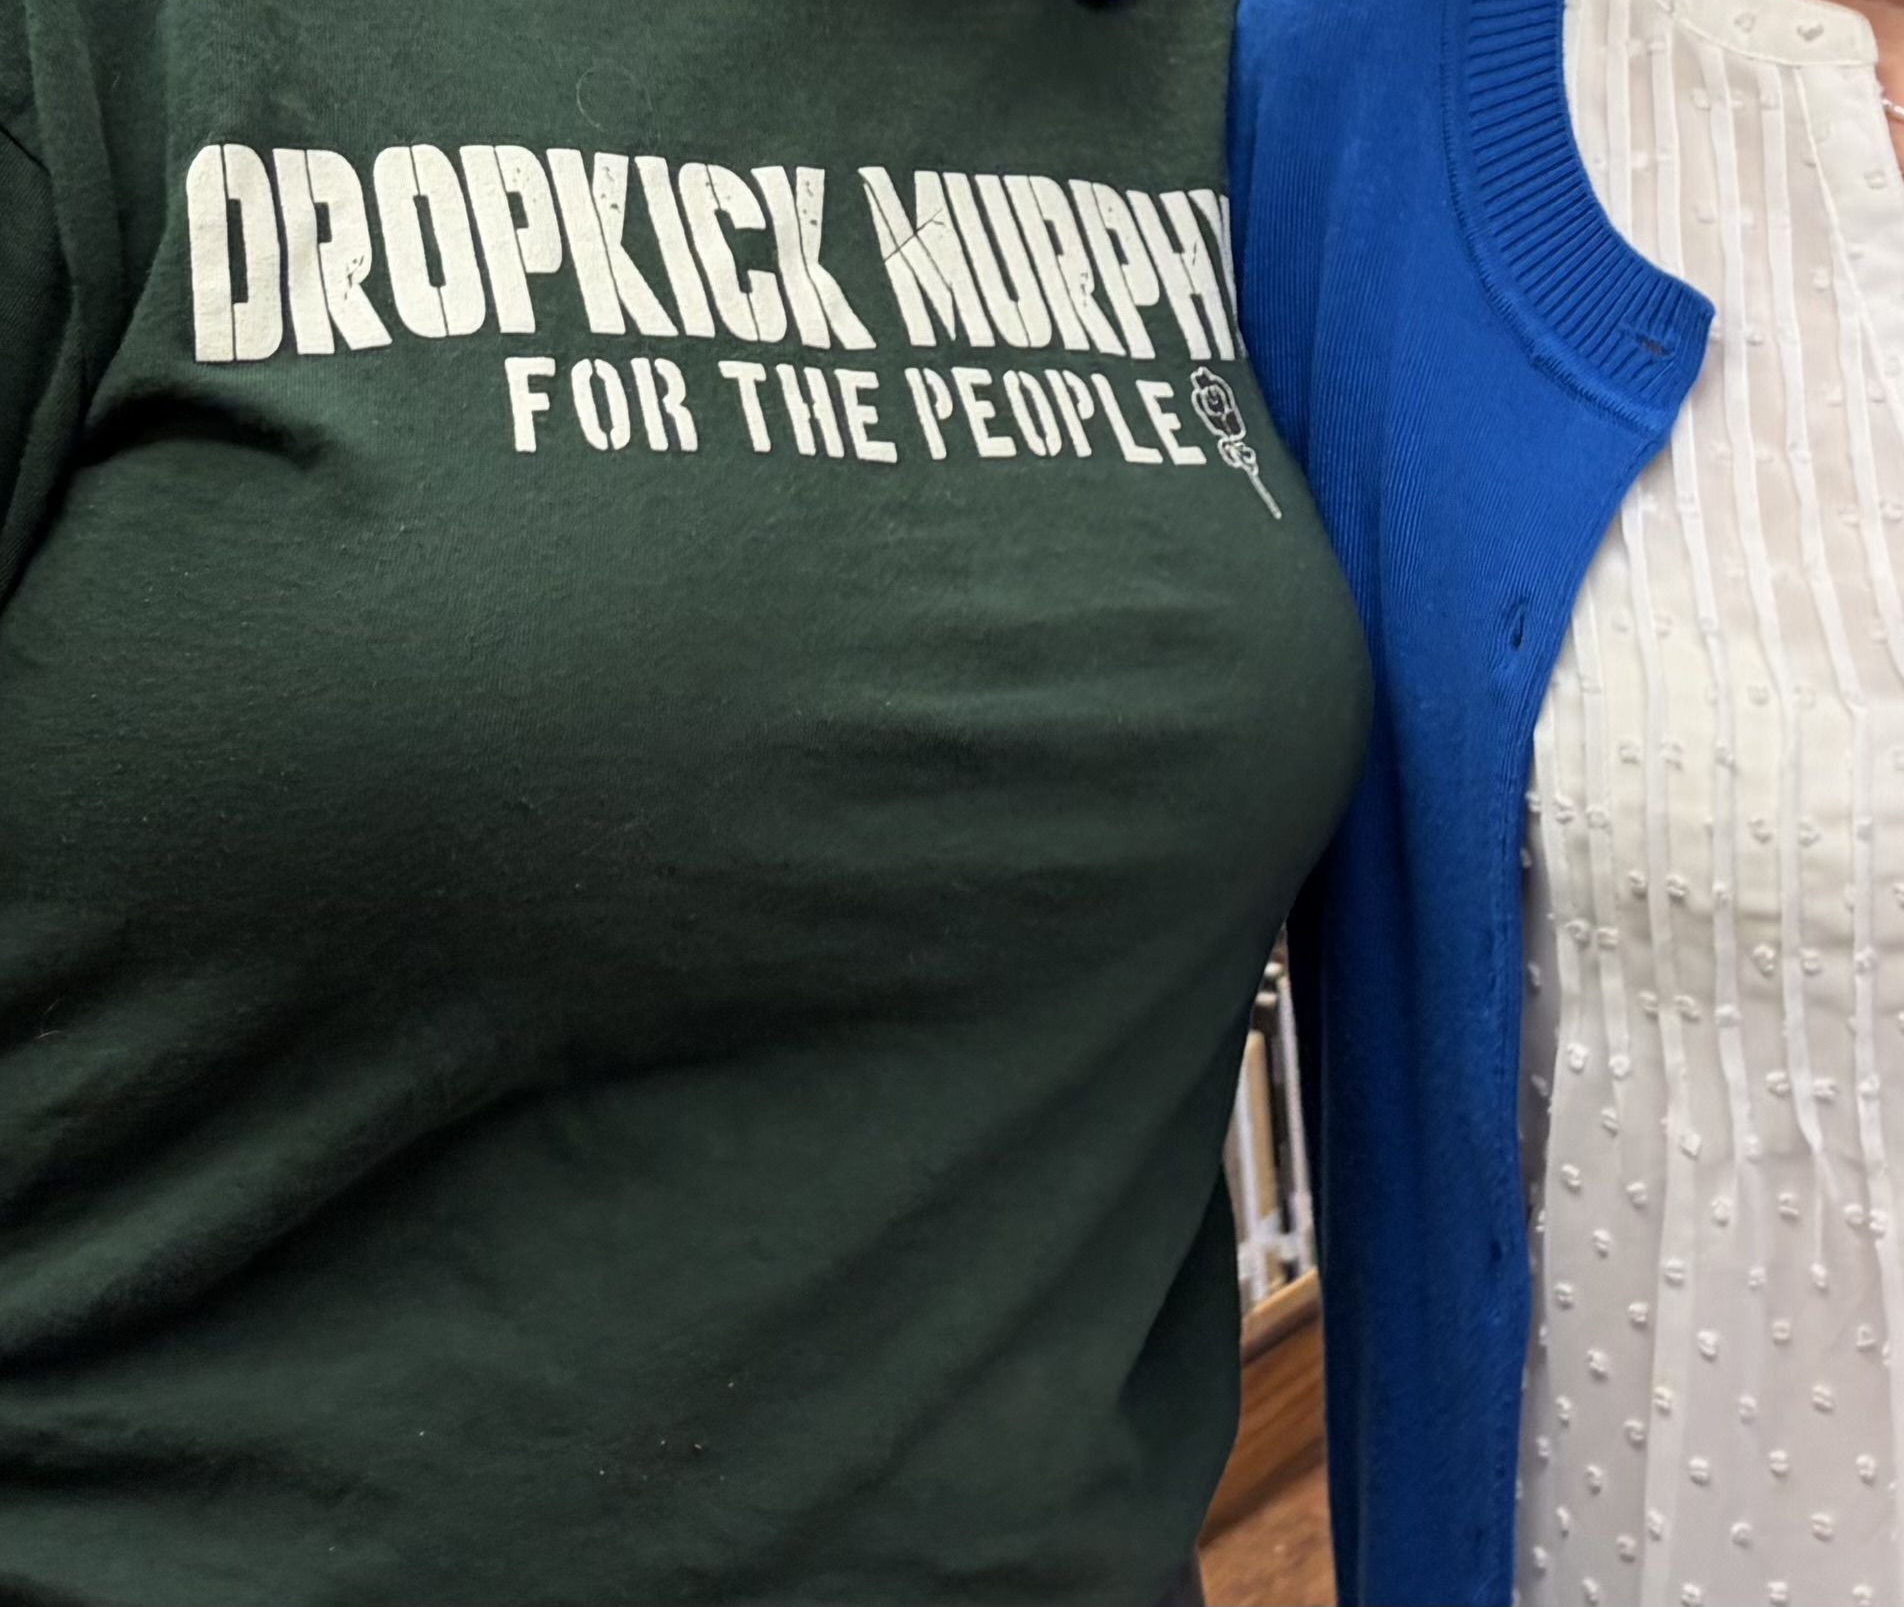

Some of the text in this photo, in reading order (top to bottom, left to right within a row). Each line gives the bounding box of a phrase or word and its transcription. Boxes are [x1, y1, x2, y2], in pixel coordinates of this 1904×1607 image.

[185, 142, 876, 362] DROPKICK
[504, 355, 1205, 467] FOR THE PEOPLE
